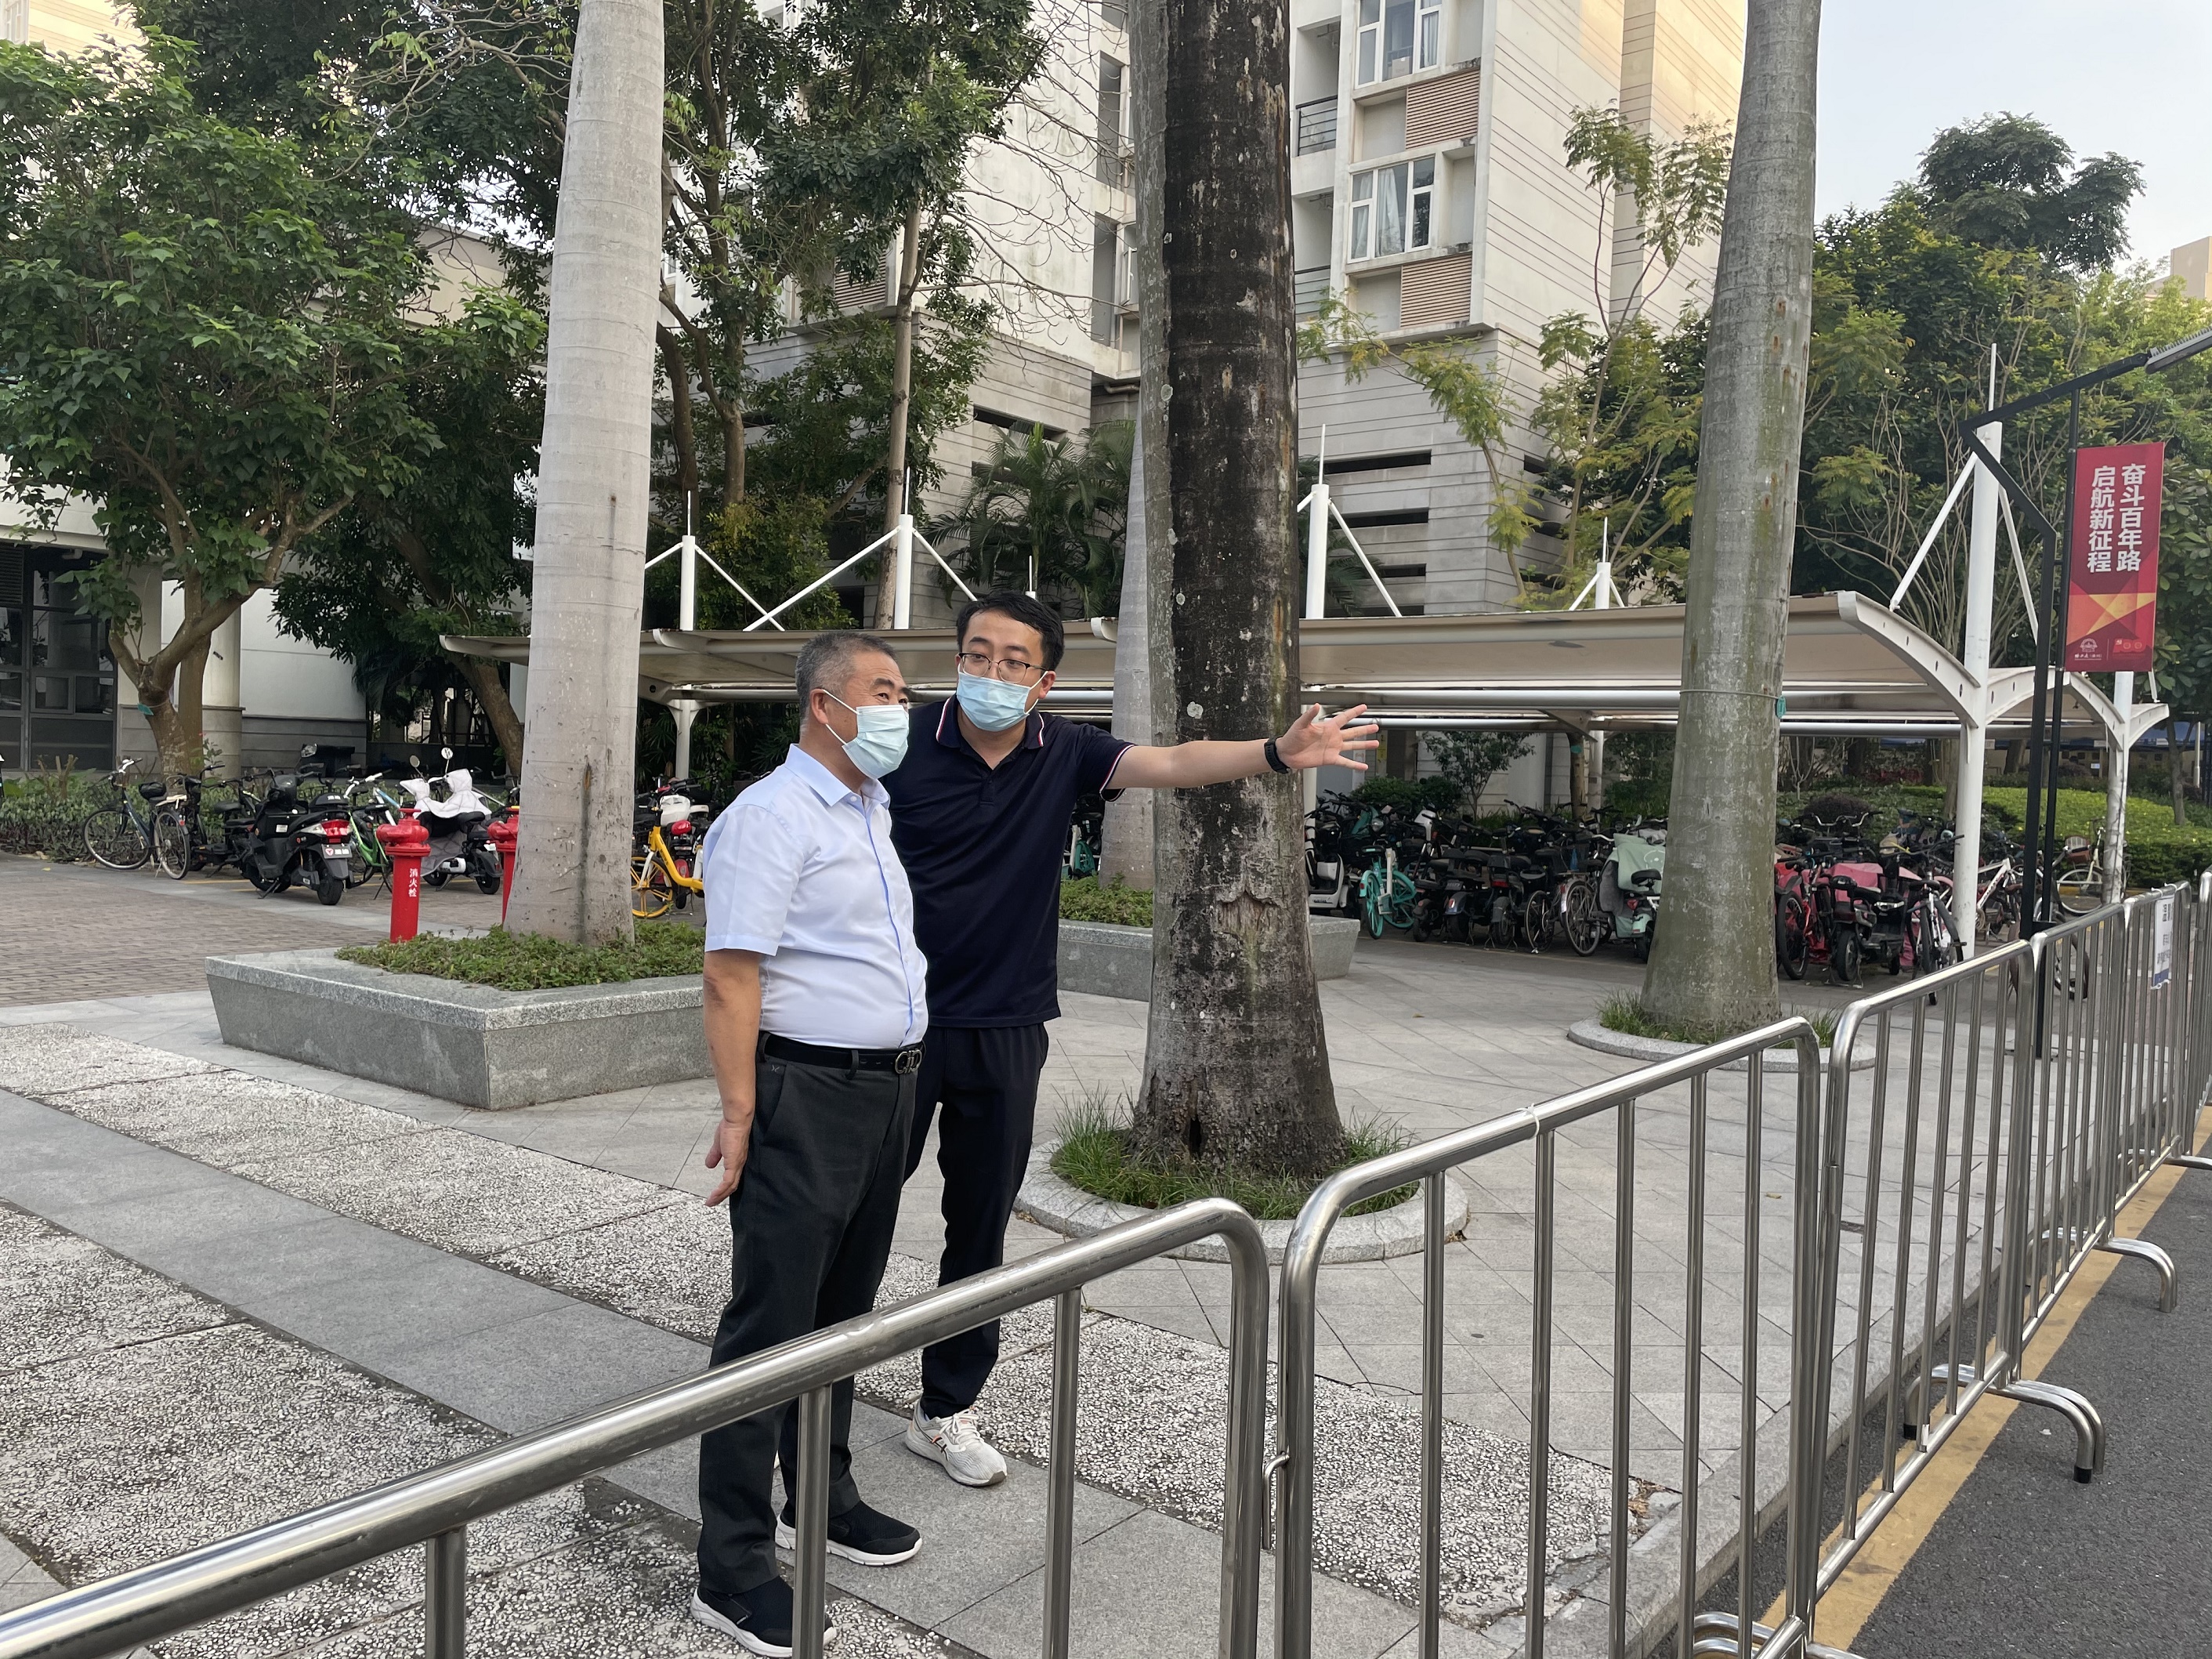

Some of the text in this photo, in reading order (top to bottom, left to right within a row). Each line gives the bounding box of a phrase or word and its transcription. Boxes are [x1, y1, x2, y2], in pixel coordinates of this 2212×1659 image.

[2087, 465, 2116, 574] 启航新征程
[2116, 463, 2146, 572] 奋斗百年路
[408, 868, 418, 898] 消火栓
